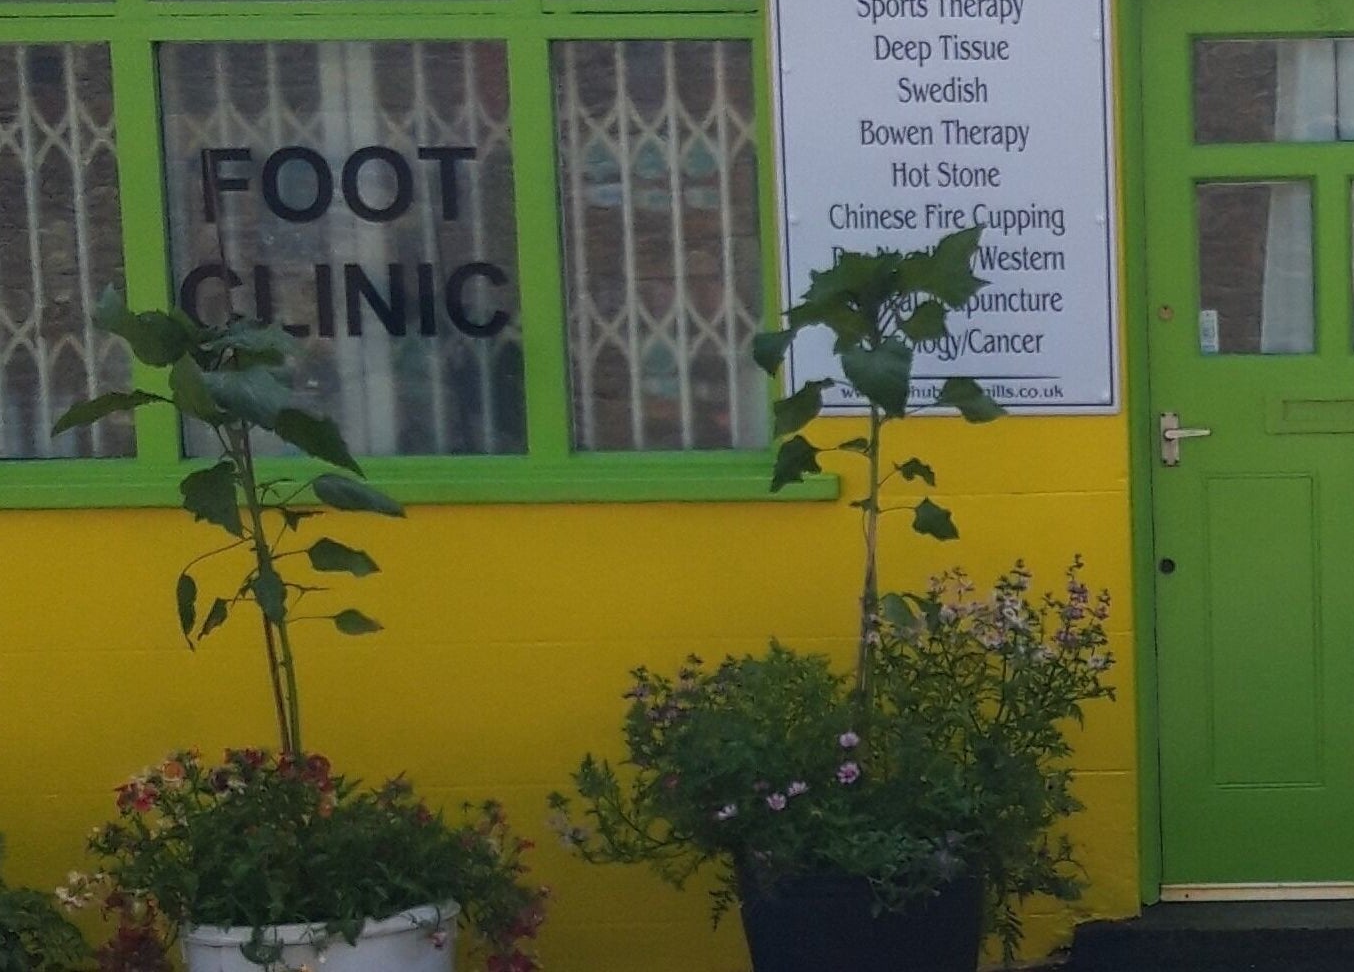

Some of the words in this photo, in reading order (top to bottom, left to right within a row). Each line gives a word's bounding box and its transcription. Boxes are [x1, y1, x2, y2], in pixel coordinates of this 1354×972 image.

[874, 35, 931, 67] Deep
[939, 35, 1009, 60] Tissue
[899, 77, 987, 103] Swedish
[861, 120, 933, 145] Bowen
[941, 119, 1029, 152] Therapy
[201, 146, 477, 222] FOOT
[892, 162, 930, 187] Hot
[938, 162, 1000, 187] Stone
[828, 204, 916, 229] Chinese
[926, 205, 965, 229] Fire
[974, 205, 1065, 236] Cupping
[181, 263, 511, 337] CLINIC
